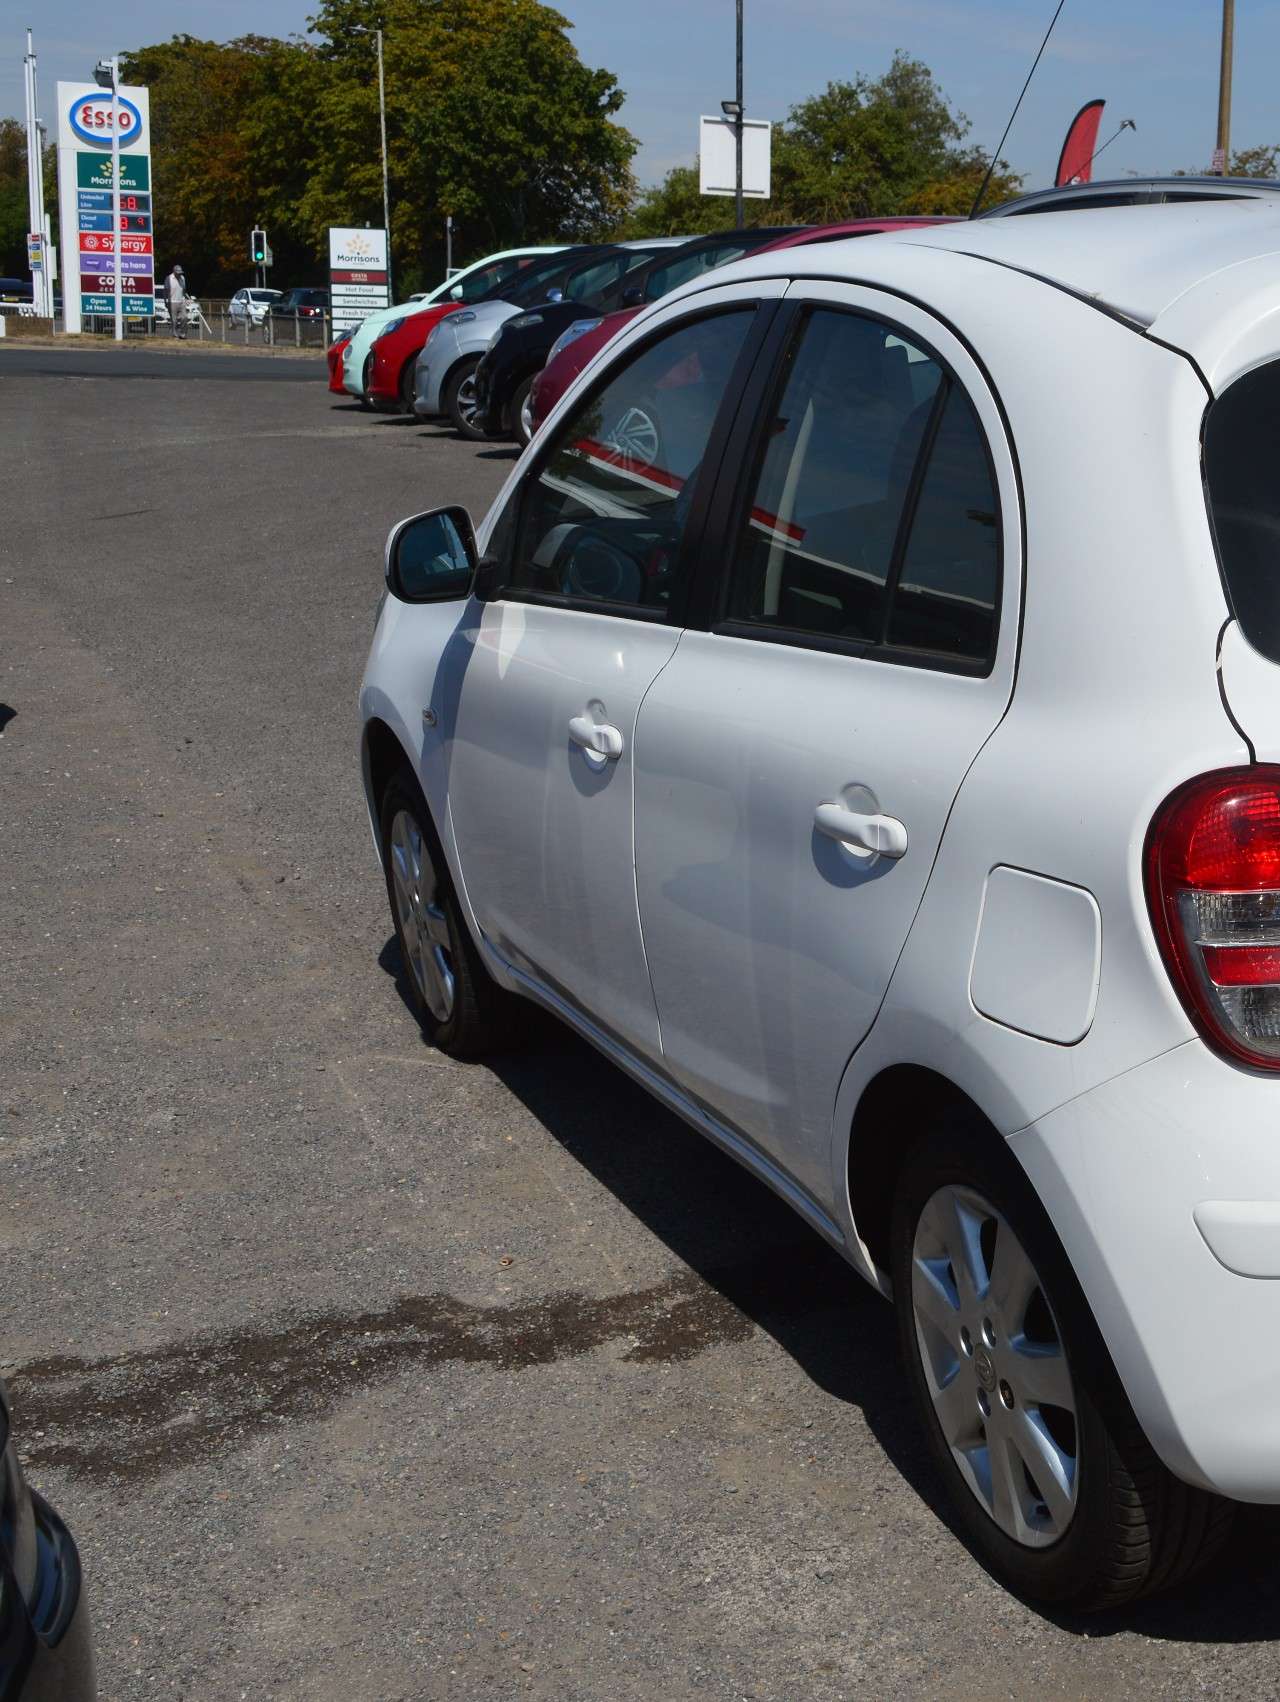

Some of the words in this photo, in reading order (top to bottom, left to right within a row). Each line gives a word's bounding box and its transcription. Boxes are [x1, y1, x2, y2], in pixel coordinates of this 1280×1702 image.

[91, 176, 137, 187] Morrons
[101, 237, 147, 252] Syergy
[337, 252, 380, 263] Morrisons
[106, 261, 129, 269] Pots
[98, 276, 136, 287] COTA
